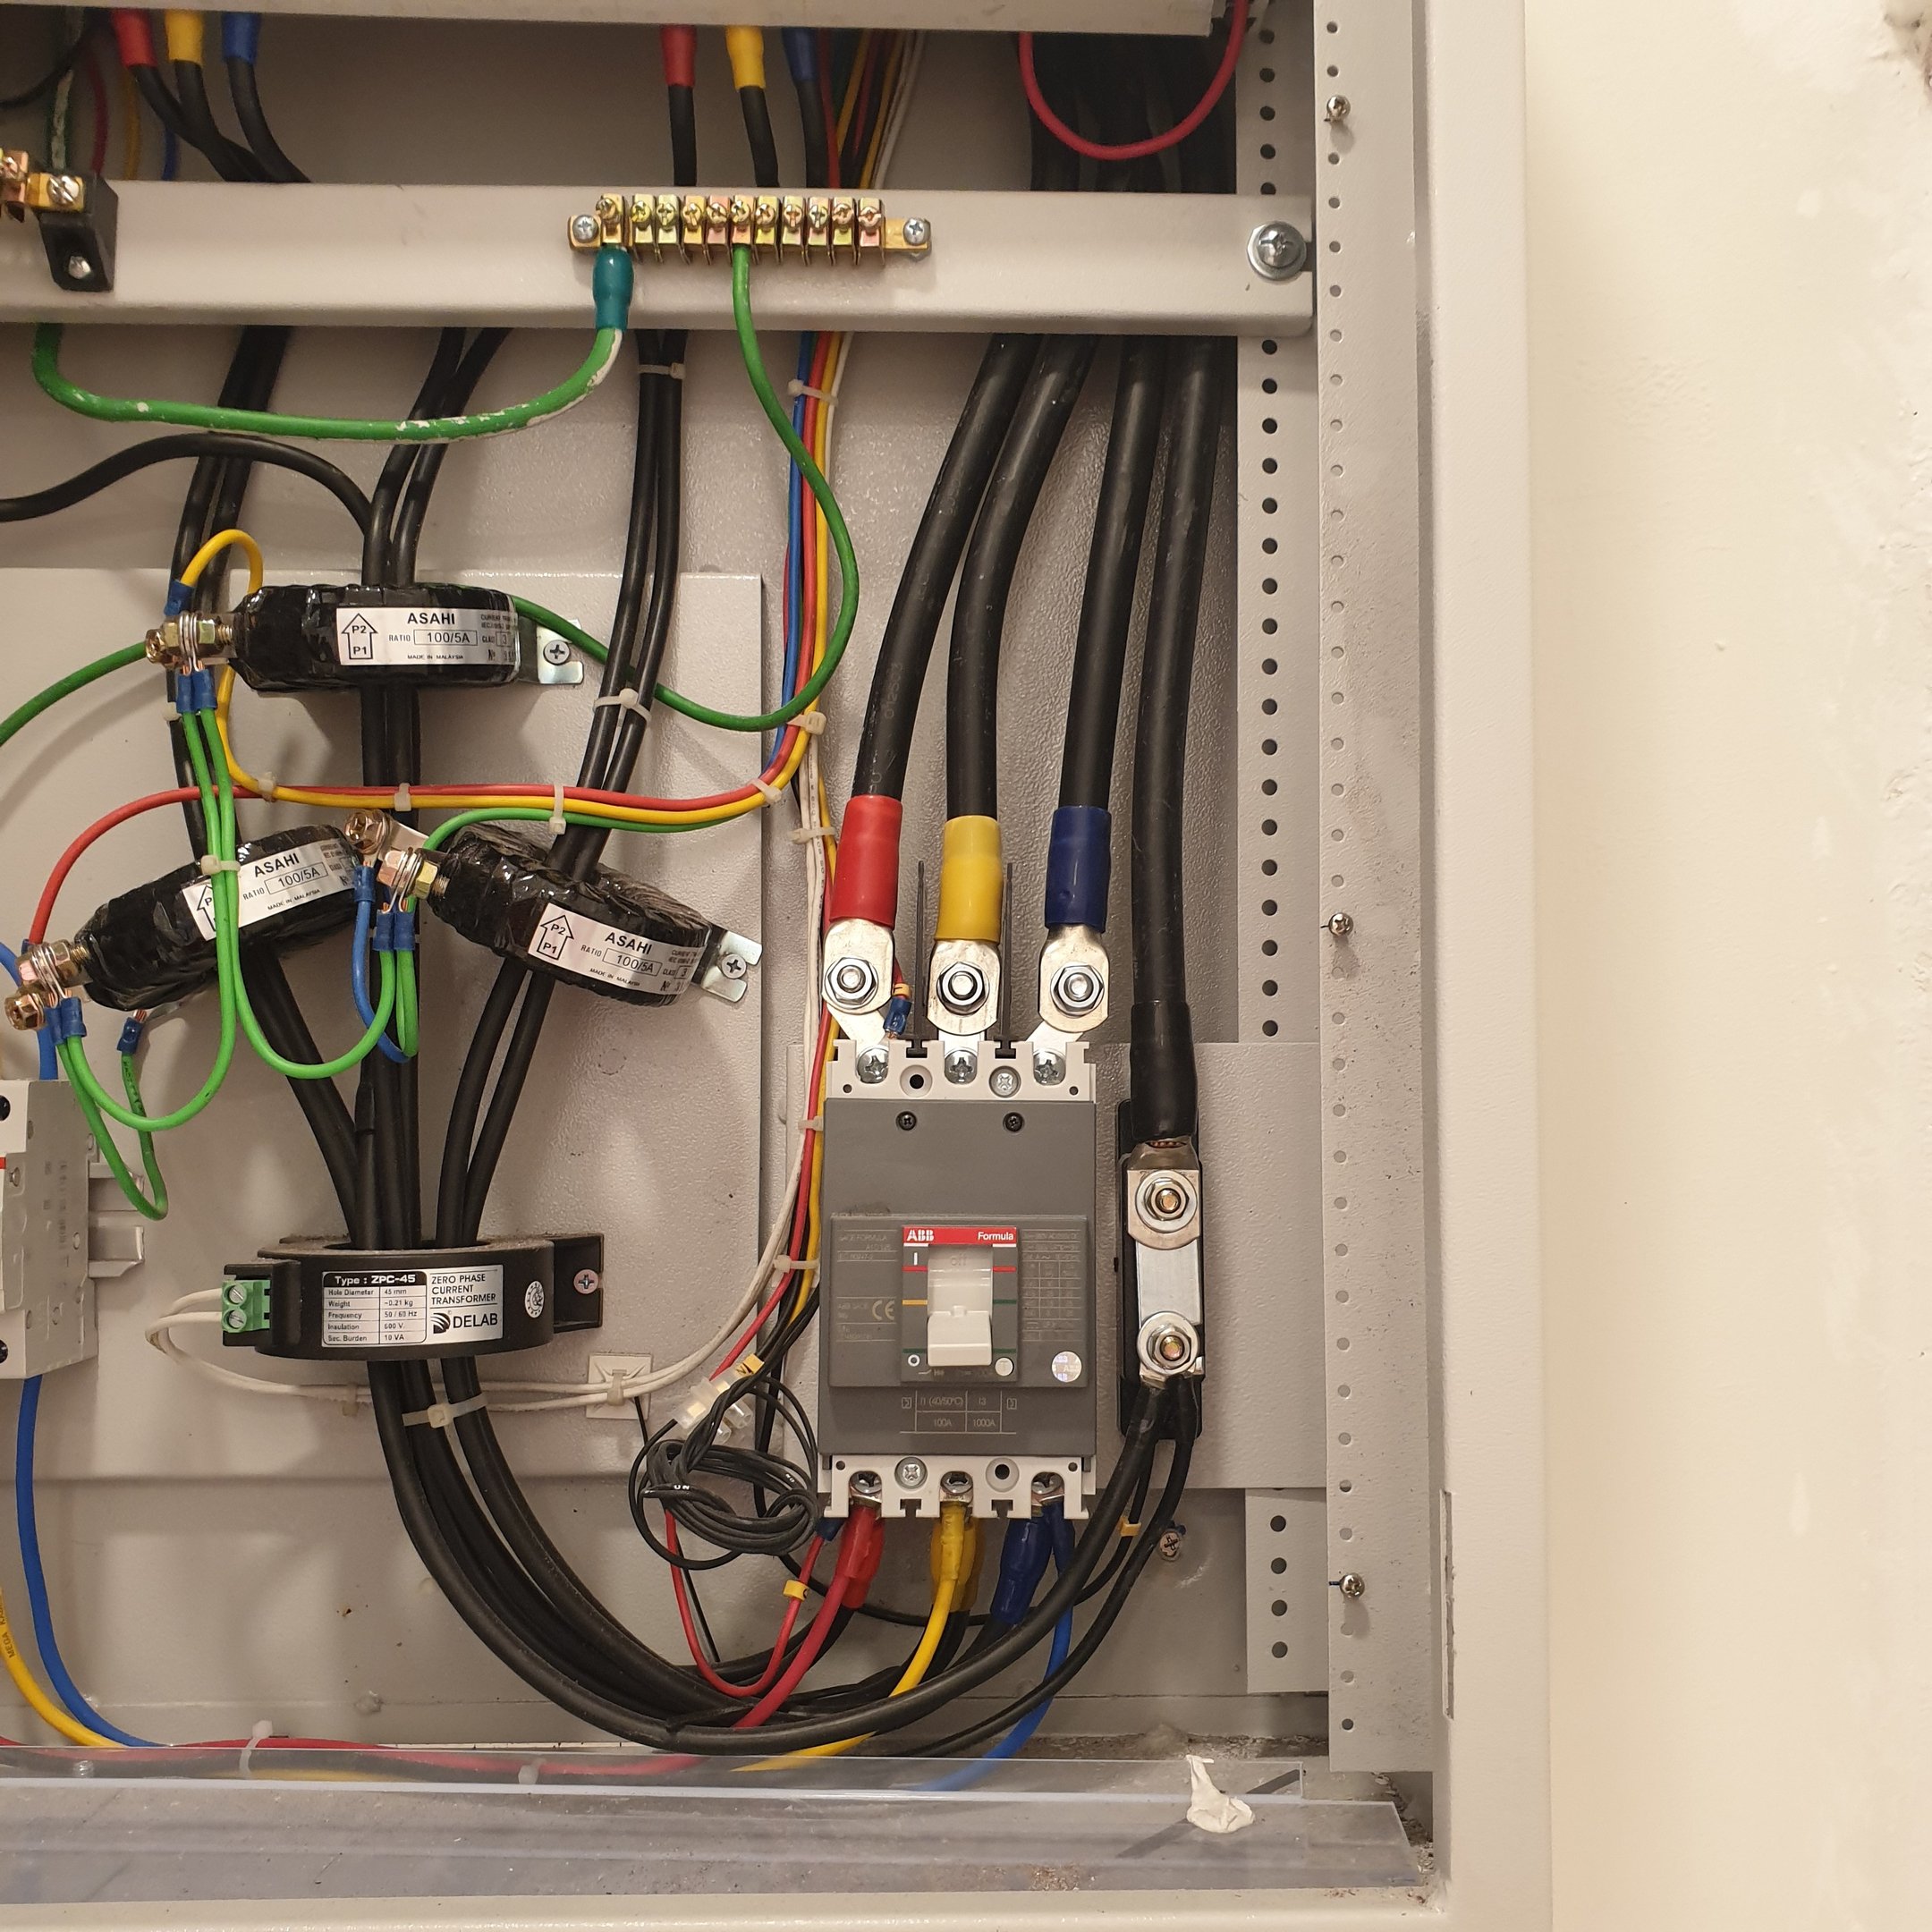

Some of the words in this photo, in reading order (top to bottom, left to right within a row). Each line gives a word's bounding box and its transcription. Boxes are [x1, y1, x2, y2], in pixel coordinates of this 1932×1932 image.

[407, 613, 455, 624] ASAHI
[352, 626, 367, 634] P2
[388, 634, 411, 642] RATIO
[427, 631, 470, 643] 100/5A
[352, 647, 367, 655] P1
[254, 852, 300, 877] ASAHI
[242, 887, 265, 900] RATIO
[278, 867, 320, 887] 100/5A
[204, 897, 213, 907] P
[267, 901, 284, 911] MADE
[293, 888, 320, 901] MALAYSIA
[550, 924, 566, 936] P2
[542, 942, 557, 954] P1
[605, 932, 652, 954] ASAHI
[580, 945, 602, 957] RATIO
[617, 954, 654, 973] 100/5A
[590, 968, 606, 977] MADE
[616, 976, 640, 987] MALAYSIA
[906, 1229, 935, 1241] ABB
[978, 1231, 1014, 1241] Formula
[335, 1275, 360, 1286] Type
[371, 1275, 416, 1284] ZPC-45
[431, 1275, 456, 1284] ZERO
[459, 1274, 486, 1283] PHASE
[431, 1284, 474, 1295] CURRENT
[404, 1299, 413, 1307] kg
[431, 1293, 496, 1305] TRANSFORMER
[453, 1313, 498, 1328] DELAB
[934, 1418, 952, 1428] 100A
[972, 1418, 996, 1428] 1000A
